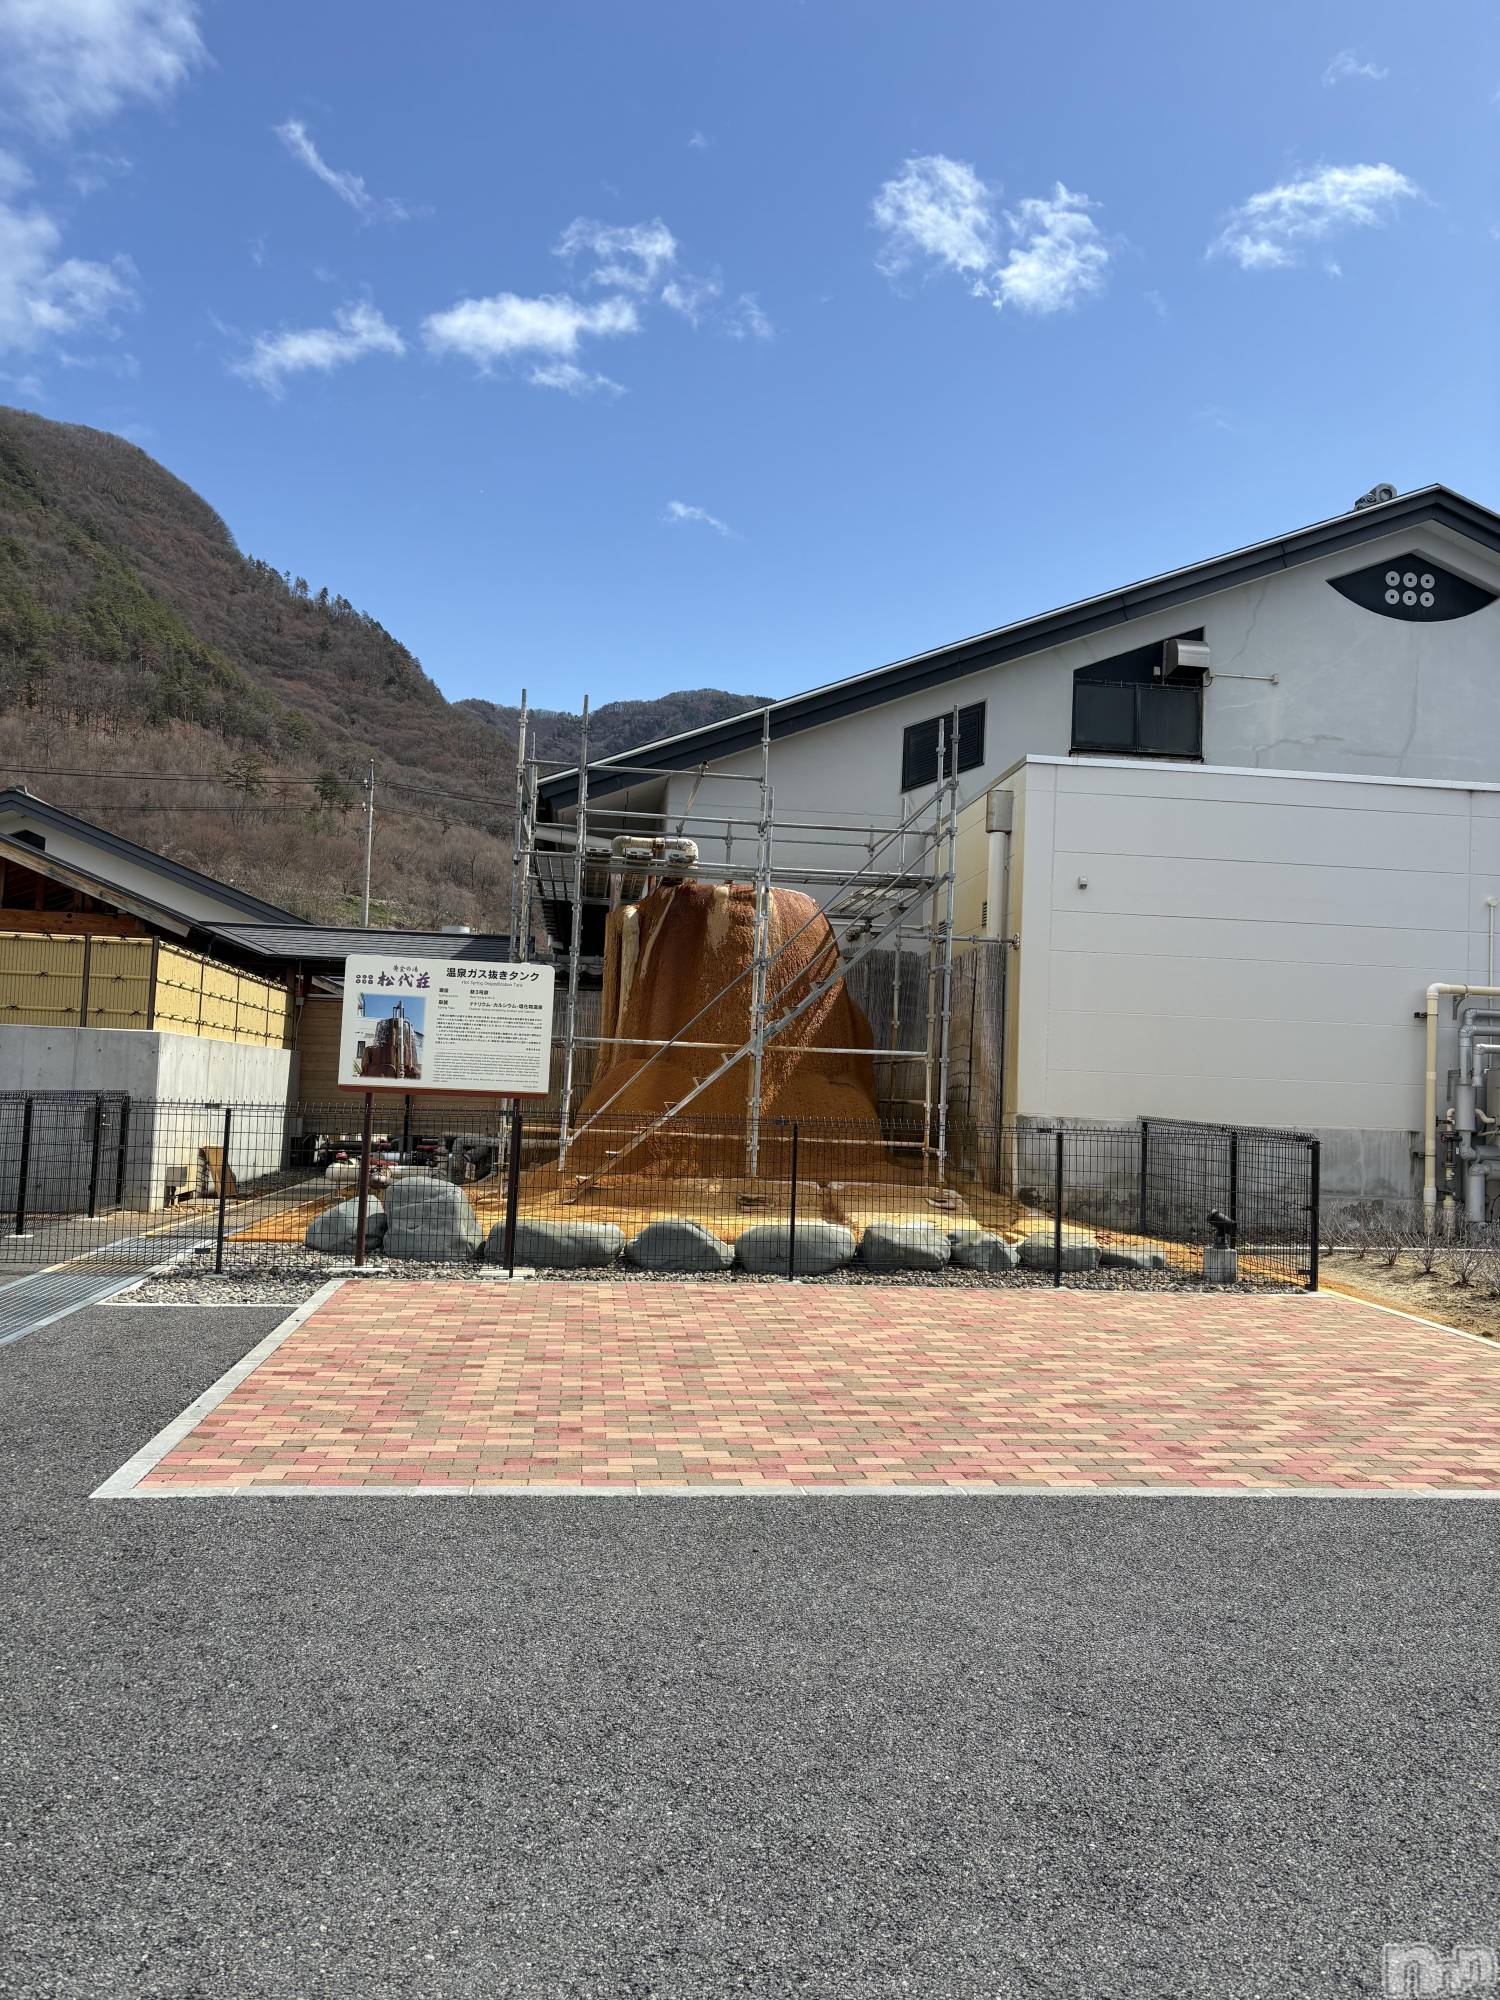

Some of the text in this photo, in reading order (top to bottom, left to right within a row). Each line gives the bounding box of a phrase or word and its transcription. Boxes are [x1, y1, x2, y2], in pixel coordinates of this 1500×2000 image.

[377, 970, 431, 989] 松代荘
[446, 967, 540, 982] 温泉ガス抜きタンク
